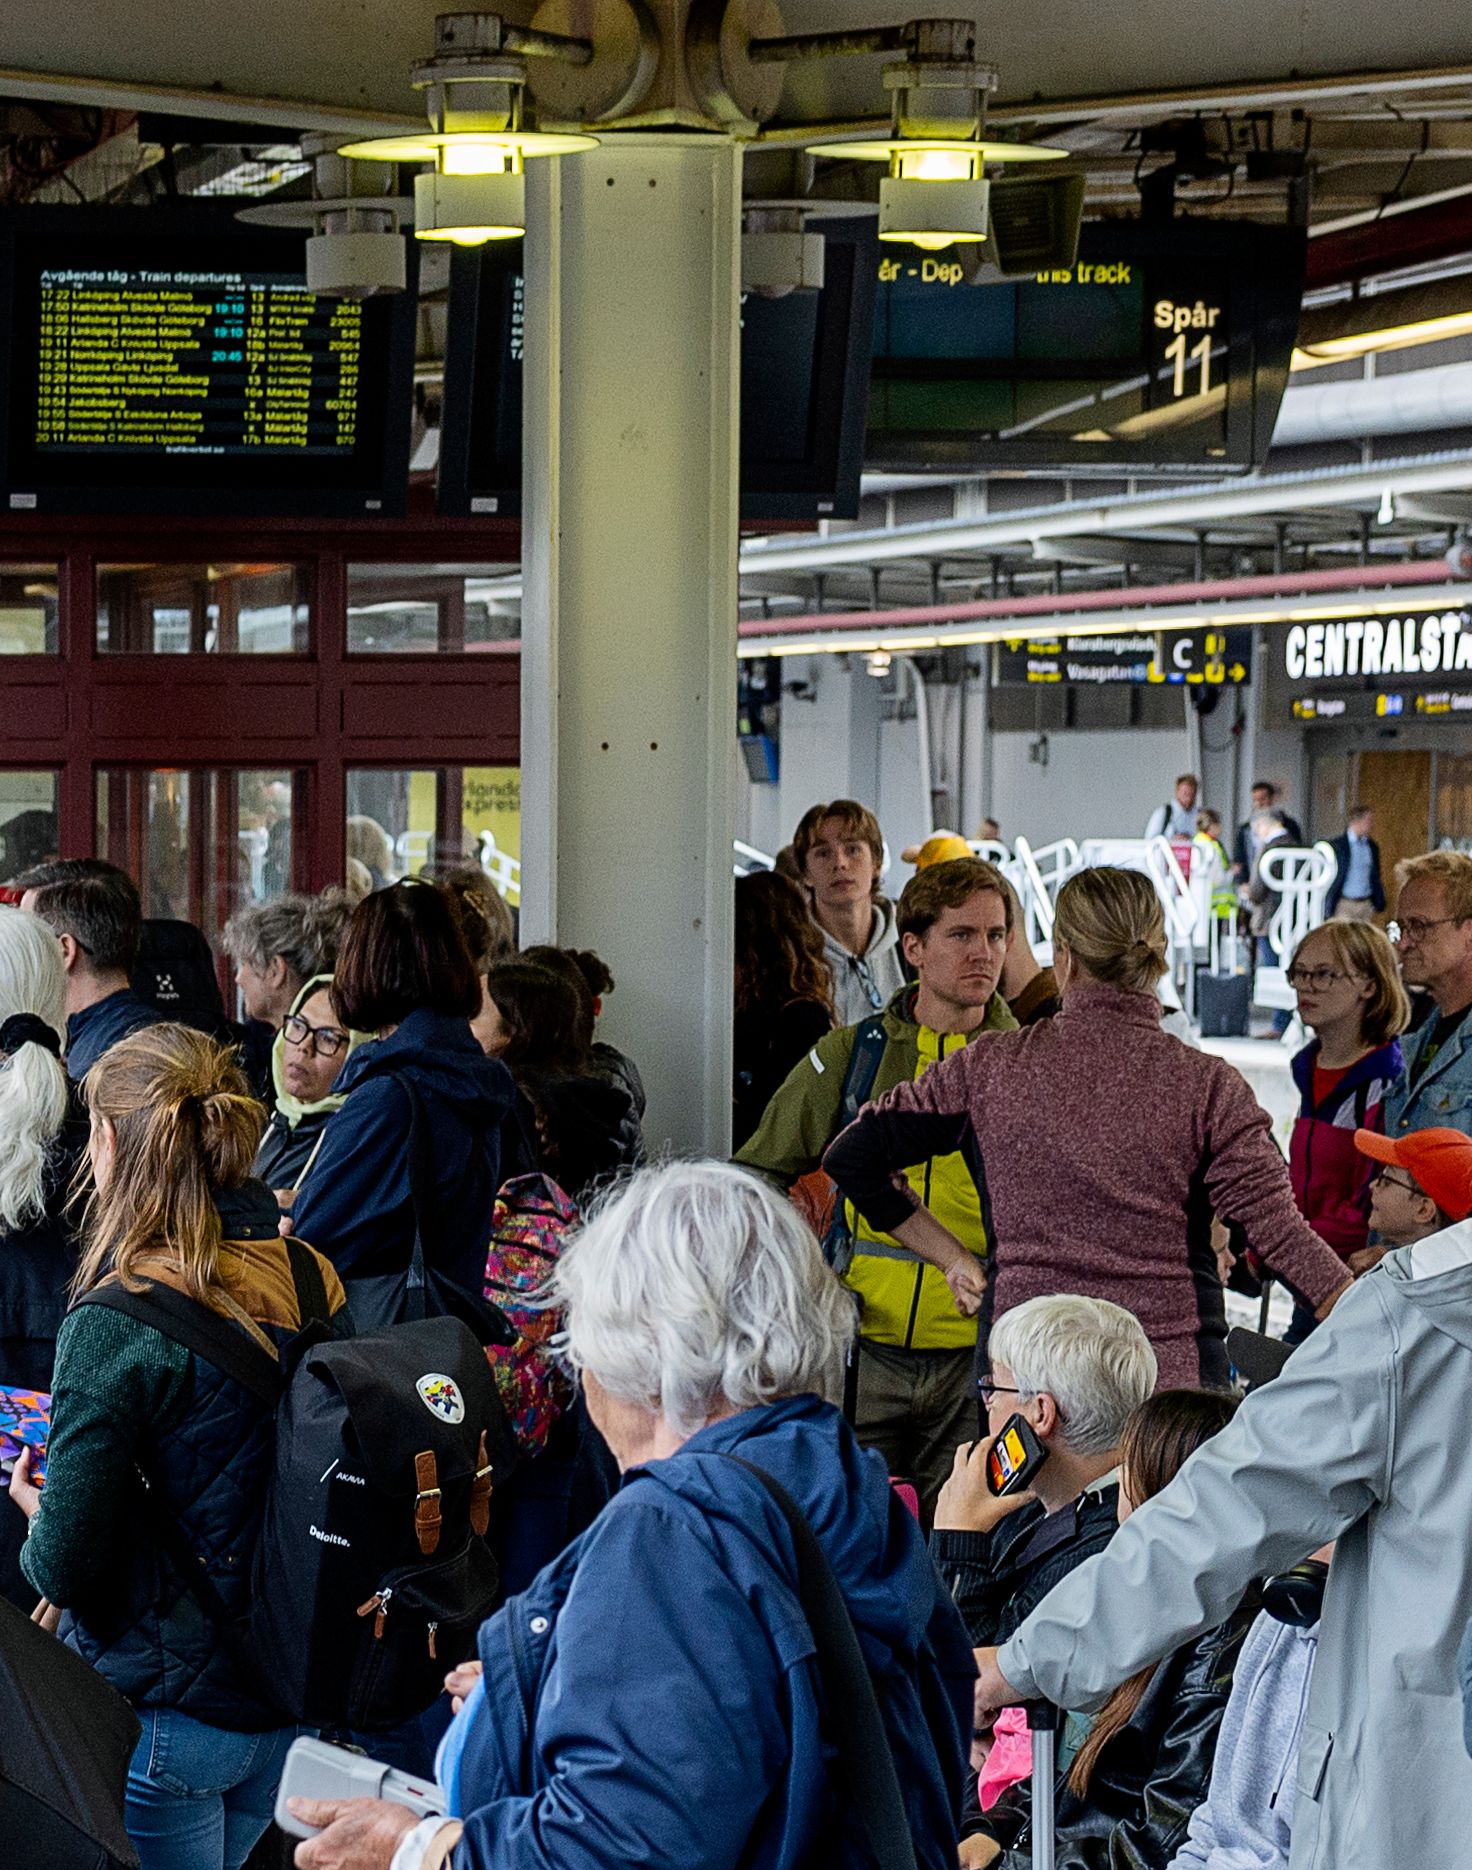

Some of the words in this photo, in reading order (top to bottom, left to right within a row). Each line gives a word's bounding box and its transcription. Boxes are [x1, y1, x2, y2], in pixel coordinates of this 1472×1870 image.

[40, 269, 105, 283] Avgående
[107, 269, 128, 284] tåg
[139, 270, 172, 282] Train
[174, 271, 241, 284] departures
[1077, 260, 1131, 284] track
[1154, 300, 1222, 334] Spår
[1164, 333, 1212, 398] 11
[1173, 638, 1194, 670] C
[309, 1524, 351, 1548] Deloitte.
